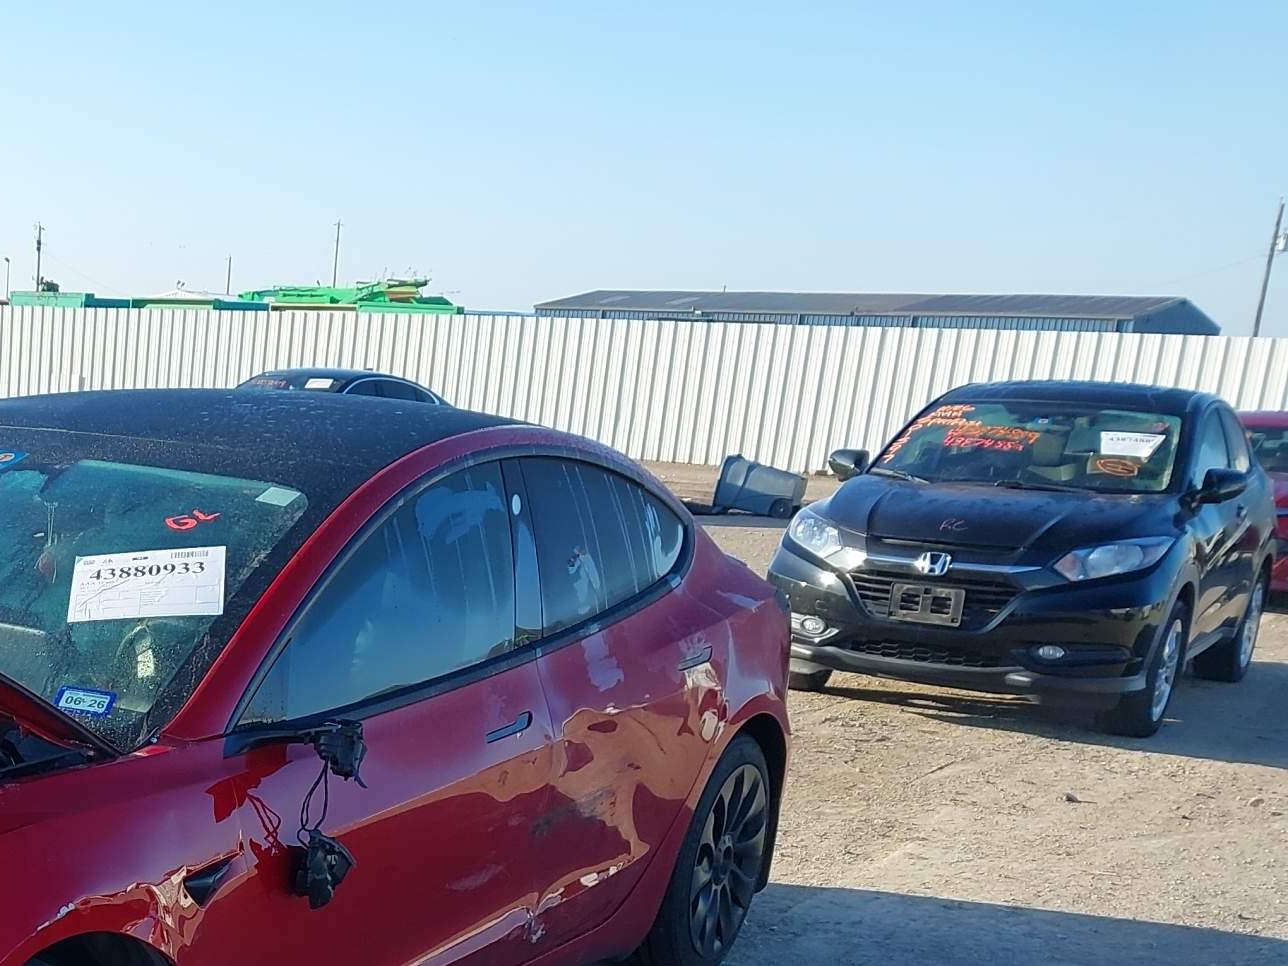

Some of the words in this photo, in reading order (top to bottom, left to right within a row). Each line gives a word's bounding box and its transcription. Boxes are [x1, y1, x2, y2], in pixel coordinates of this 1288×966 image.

[89, 561, 206, 581] 43880933
[64, 695, 83, 706] 06
[87, 699, 107, 709] 26
